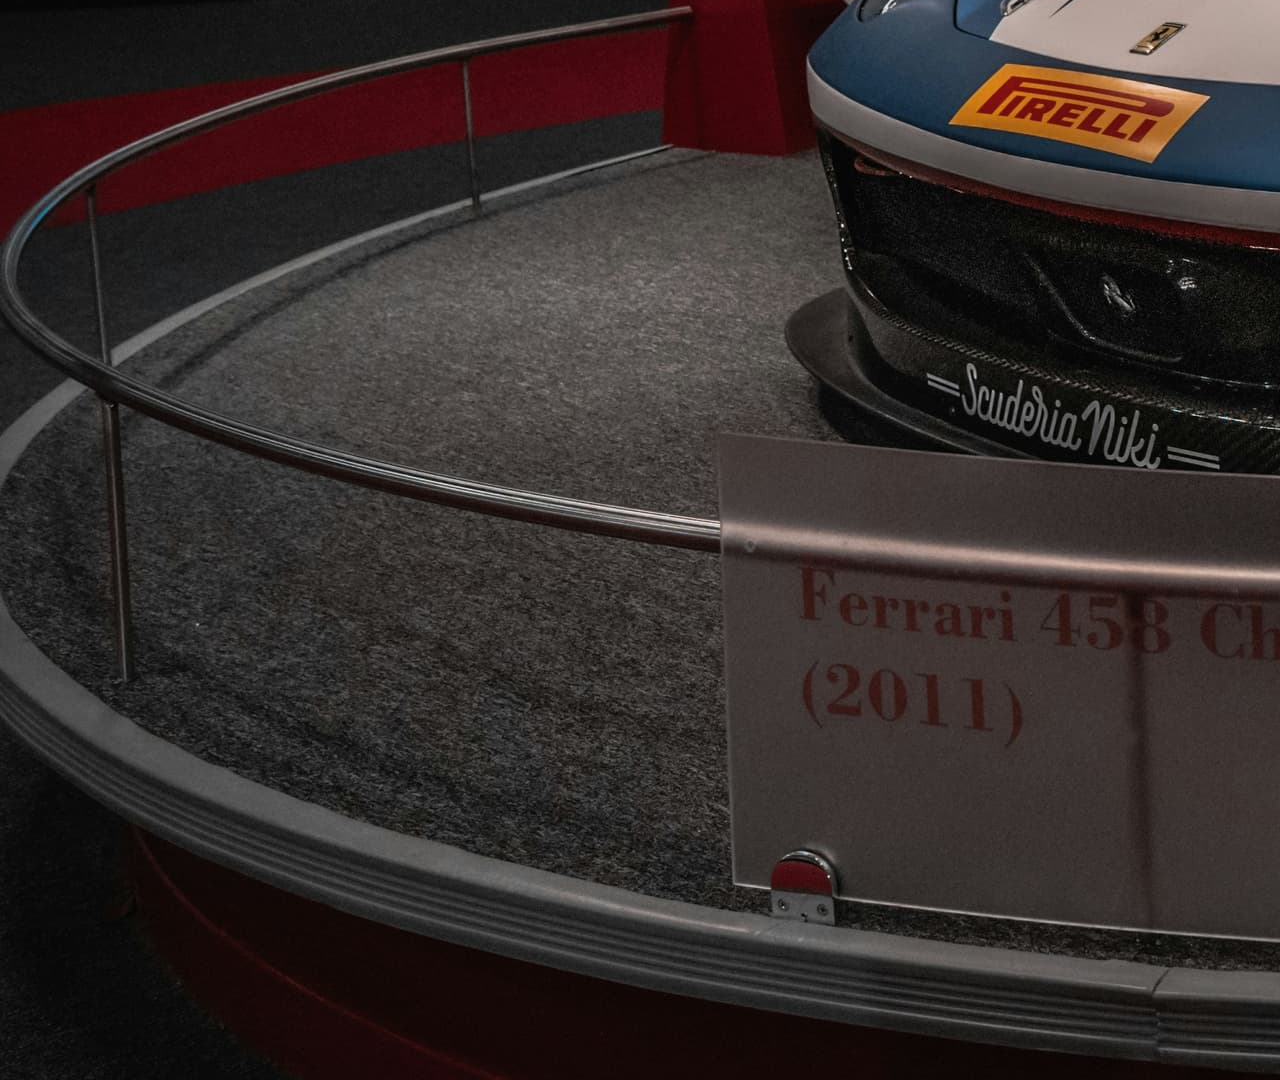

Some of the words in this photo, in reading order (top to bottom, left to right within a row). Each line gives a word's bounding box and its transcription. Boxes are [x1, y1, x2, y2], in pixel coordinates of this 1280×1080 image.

[976, 76, 1174, 142] PIRELLI
[961, 362, 1082, 451] Scuderia
[1081, 400, 1161, 470] Niki
[800, 566, 1018, 642] Ferrari
[1039, 592, 1172, 655] 458
[802, 661, 1024, 747] (2011)
